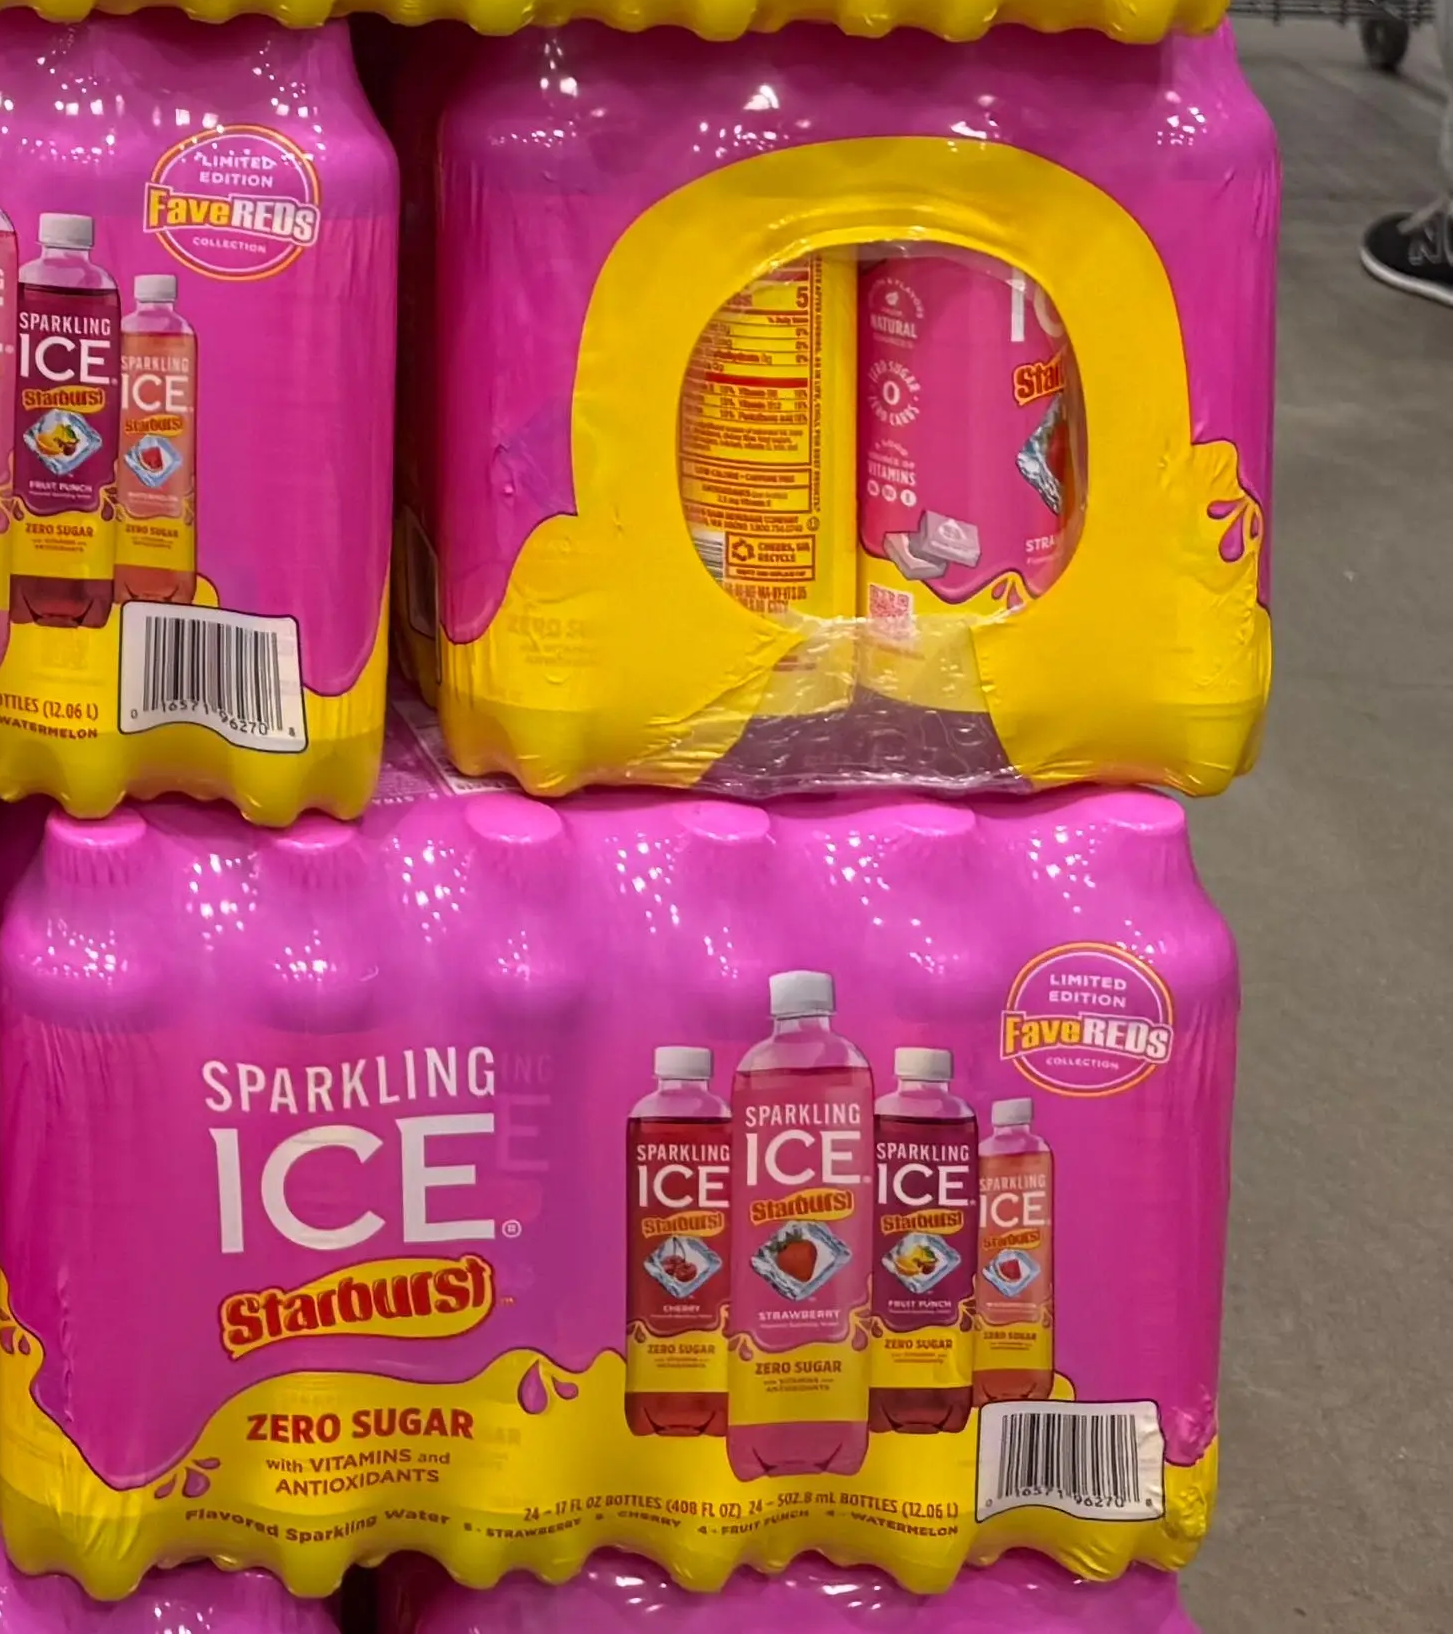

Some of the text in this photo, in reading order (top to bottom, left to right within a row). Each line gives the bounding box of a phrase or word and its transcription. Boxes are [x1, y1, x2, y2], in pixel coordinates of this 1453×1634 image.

[202, 155, 276, 170] LIMITED
[199, 171, 274, 188] EDITION
[192, 236, 267, 254] COLLECTION
[1050, 974, 1127, 991] LIMITED
[1048, 990, 1127, 1008] EDITION
[1046, 1057, 1119, 1070] COLLECTION
[203, 1047, 494, 1113] SPARKLING
[227, 1260, 490, 1343] Starburst
[247, 1408, 473, 1443] ZERO SUGAR
[309, 1449, 412, 1473] VITAMINS
[275, 1469, 439, 1496] ANTIOXIDANTS
